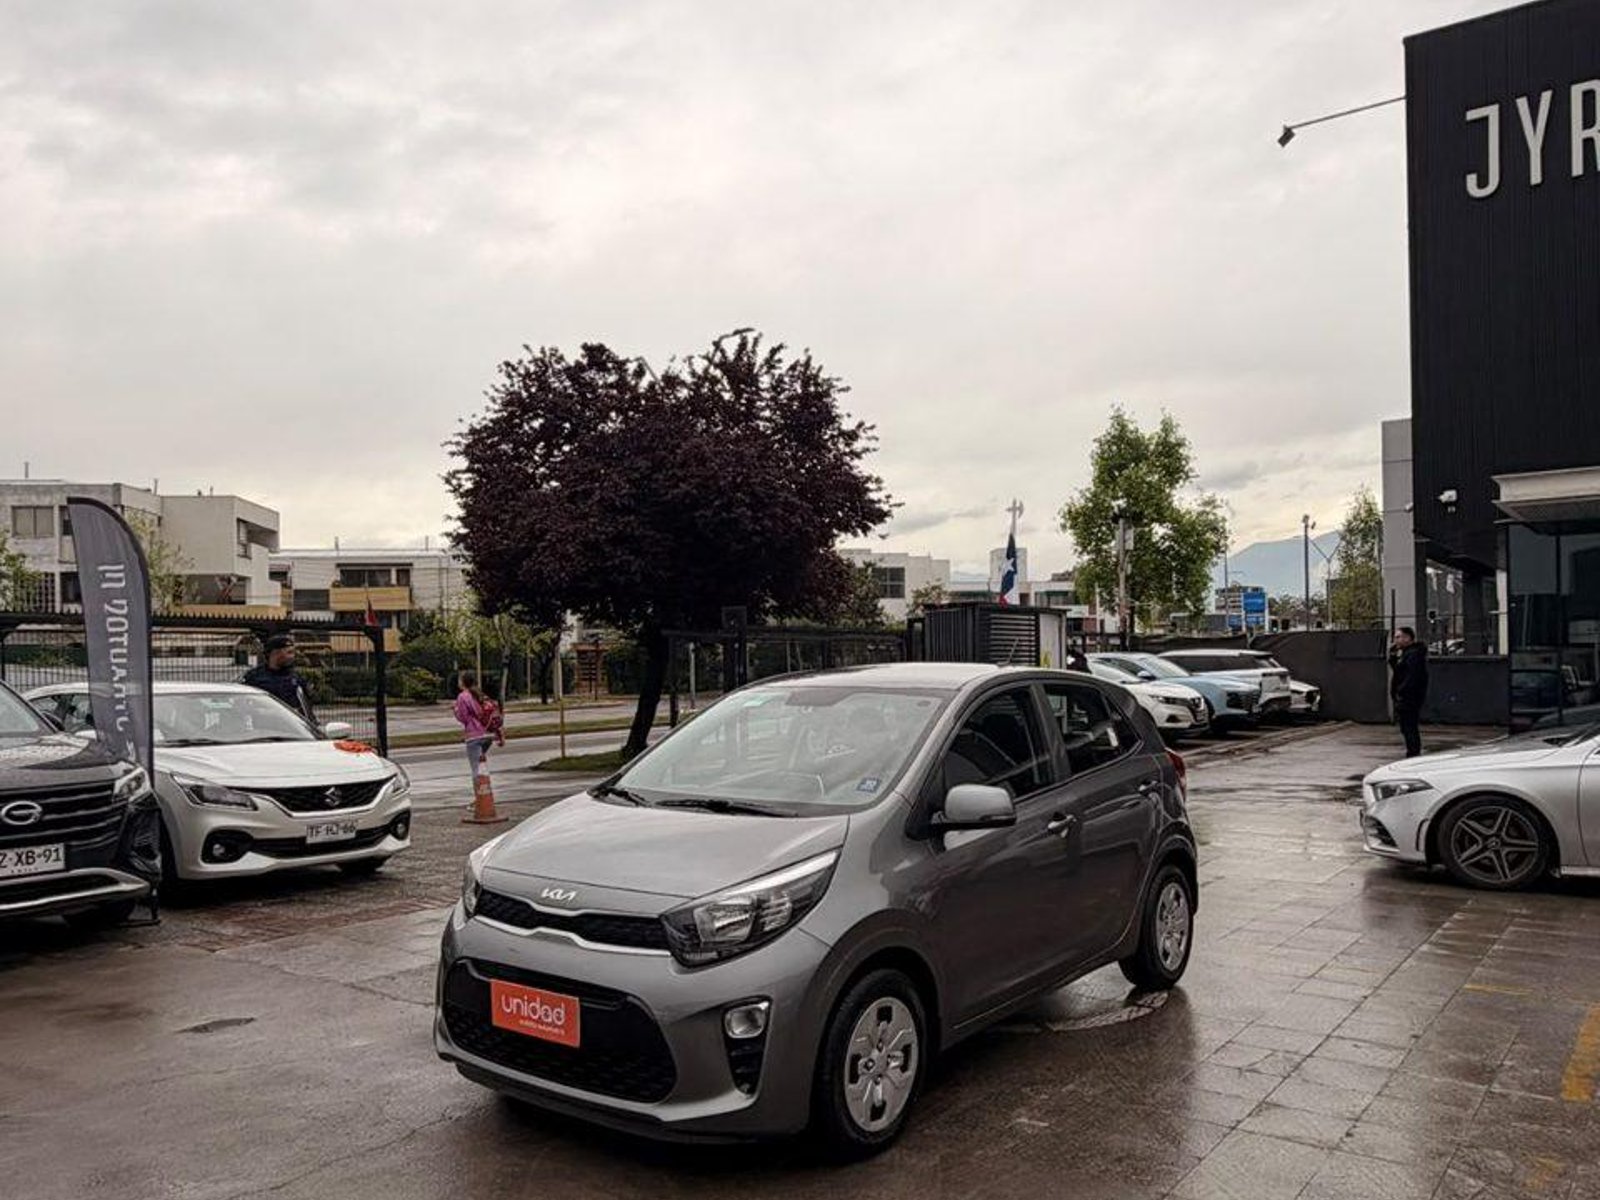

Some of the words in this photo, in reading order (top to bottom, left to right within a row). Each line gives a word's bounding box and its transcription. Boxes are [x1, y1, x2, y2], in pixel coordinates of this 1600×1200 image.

[1465, 79, 1600, 198] JYR
[541, 887, 577, 902] KIA
[501, 994, 566, 1025] unidad
